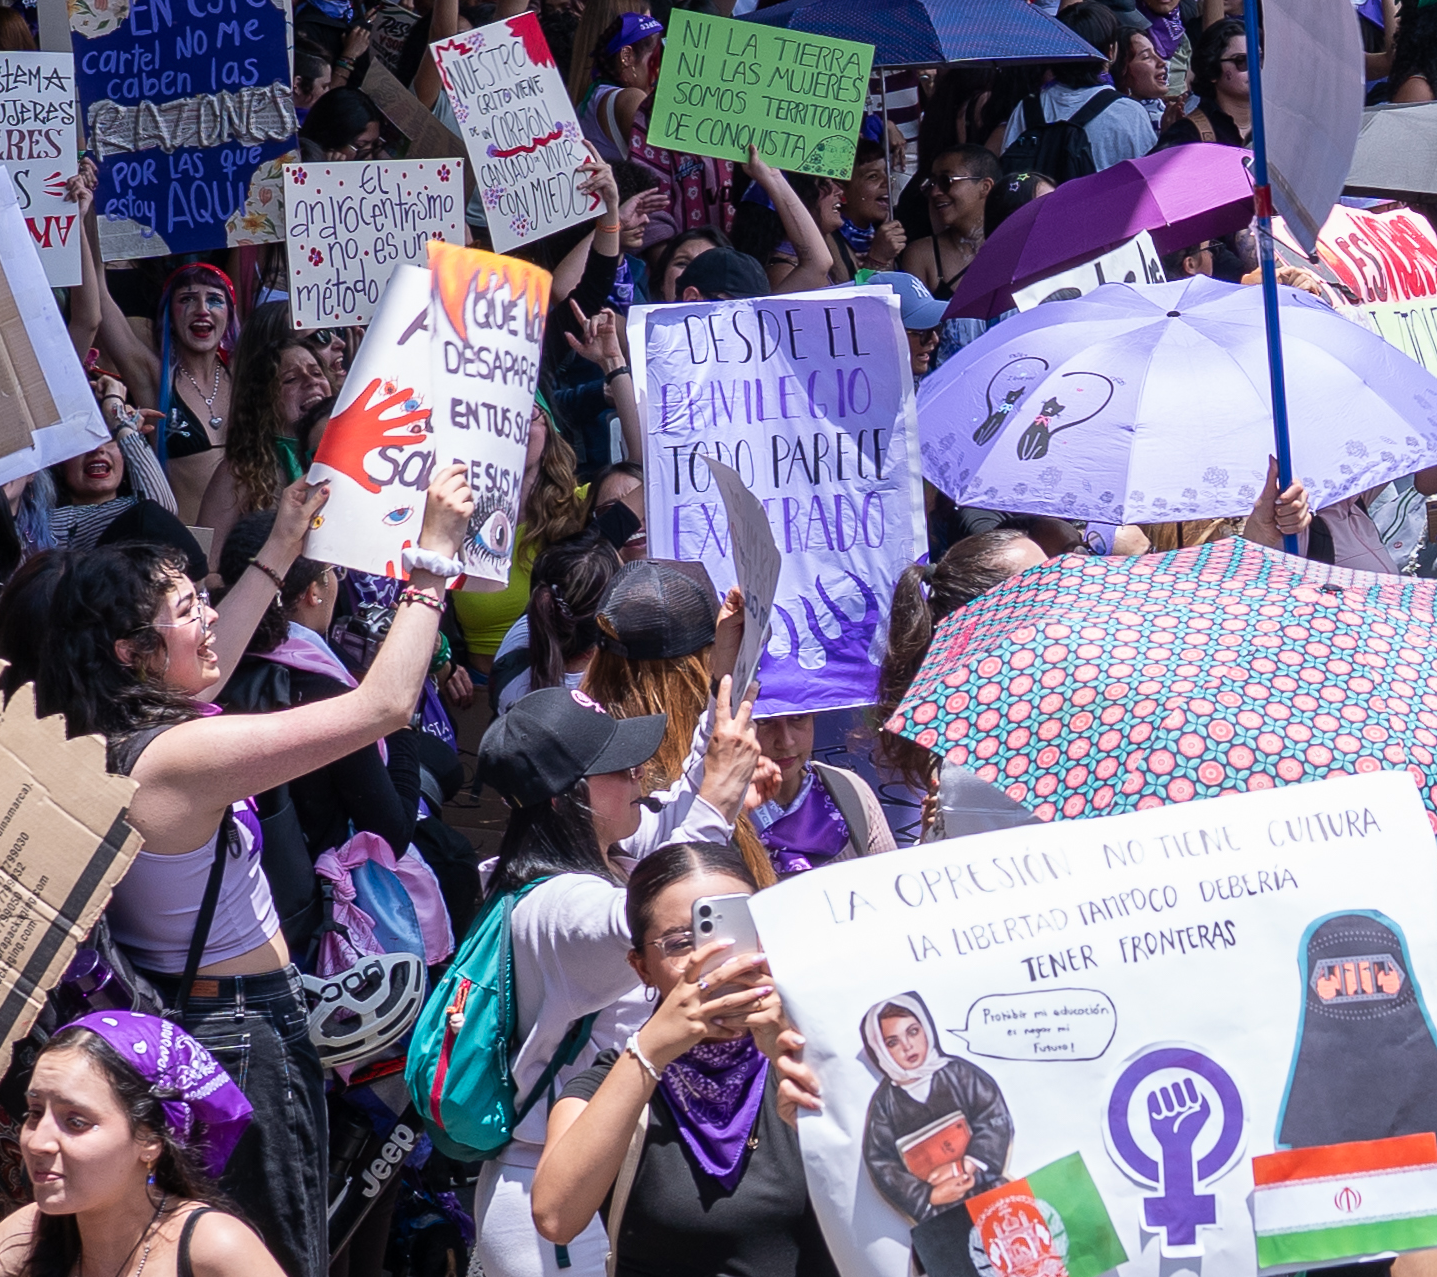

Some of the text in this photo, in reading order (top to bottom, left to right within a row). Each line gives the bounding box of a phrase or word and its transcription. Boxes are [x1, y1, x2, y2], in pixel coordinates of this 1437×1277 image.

[106, 56, 260, 101] caben las
[446, 40, 527, 106] NUESTRO
[676, 51, 865, 104] NI LAS MUJERES
[664, 111, 807, 162] DE CONQUISTA
[672, 80, 856, 133] SOMOS TERRITORIO
[289, 182, 455, 241] androcentrismo
[683, 305, 872, 366] DESDE EL
[660, 366, 873, 433] PRIVILEGIO
[661, 427, 891, 497] TODO PARECE
[822, 805, 1384, 926] LA OPRESIÓN NO TIENE CULTURA
[905, 863, 1300, 964] LA LIBERTAD TAMPOCO DEBERÍA
[1019, 917, 1239, 985] TENER FRONTERAS
[982, 1002, 1112, 1027] Prohibir mi educación
[361, 1122, 416, 1198] Jeep
